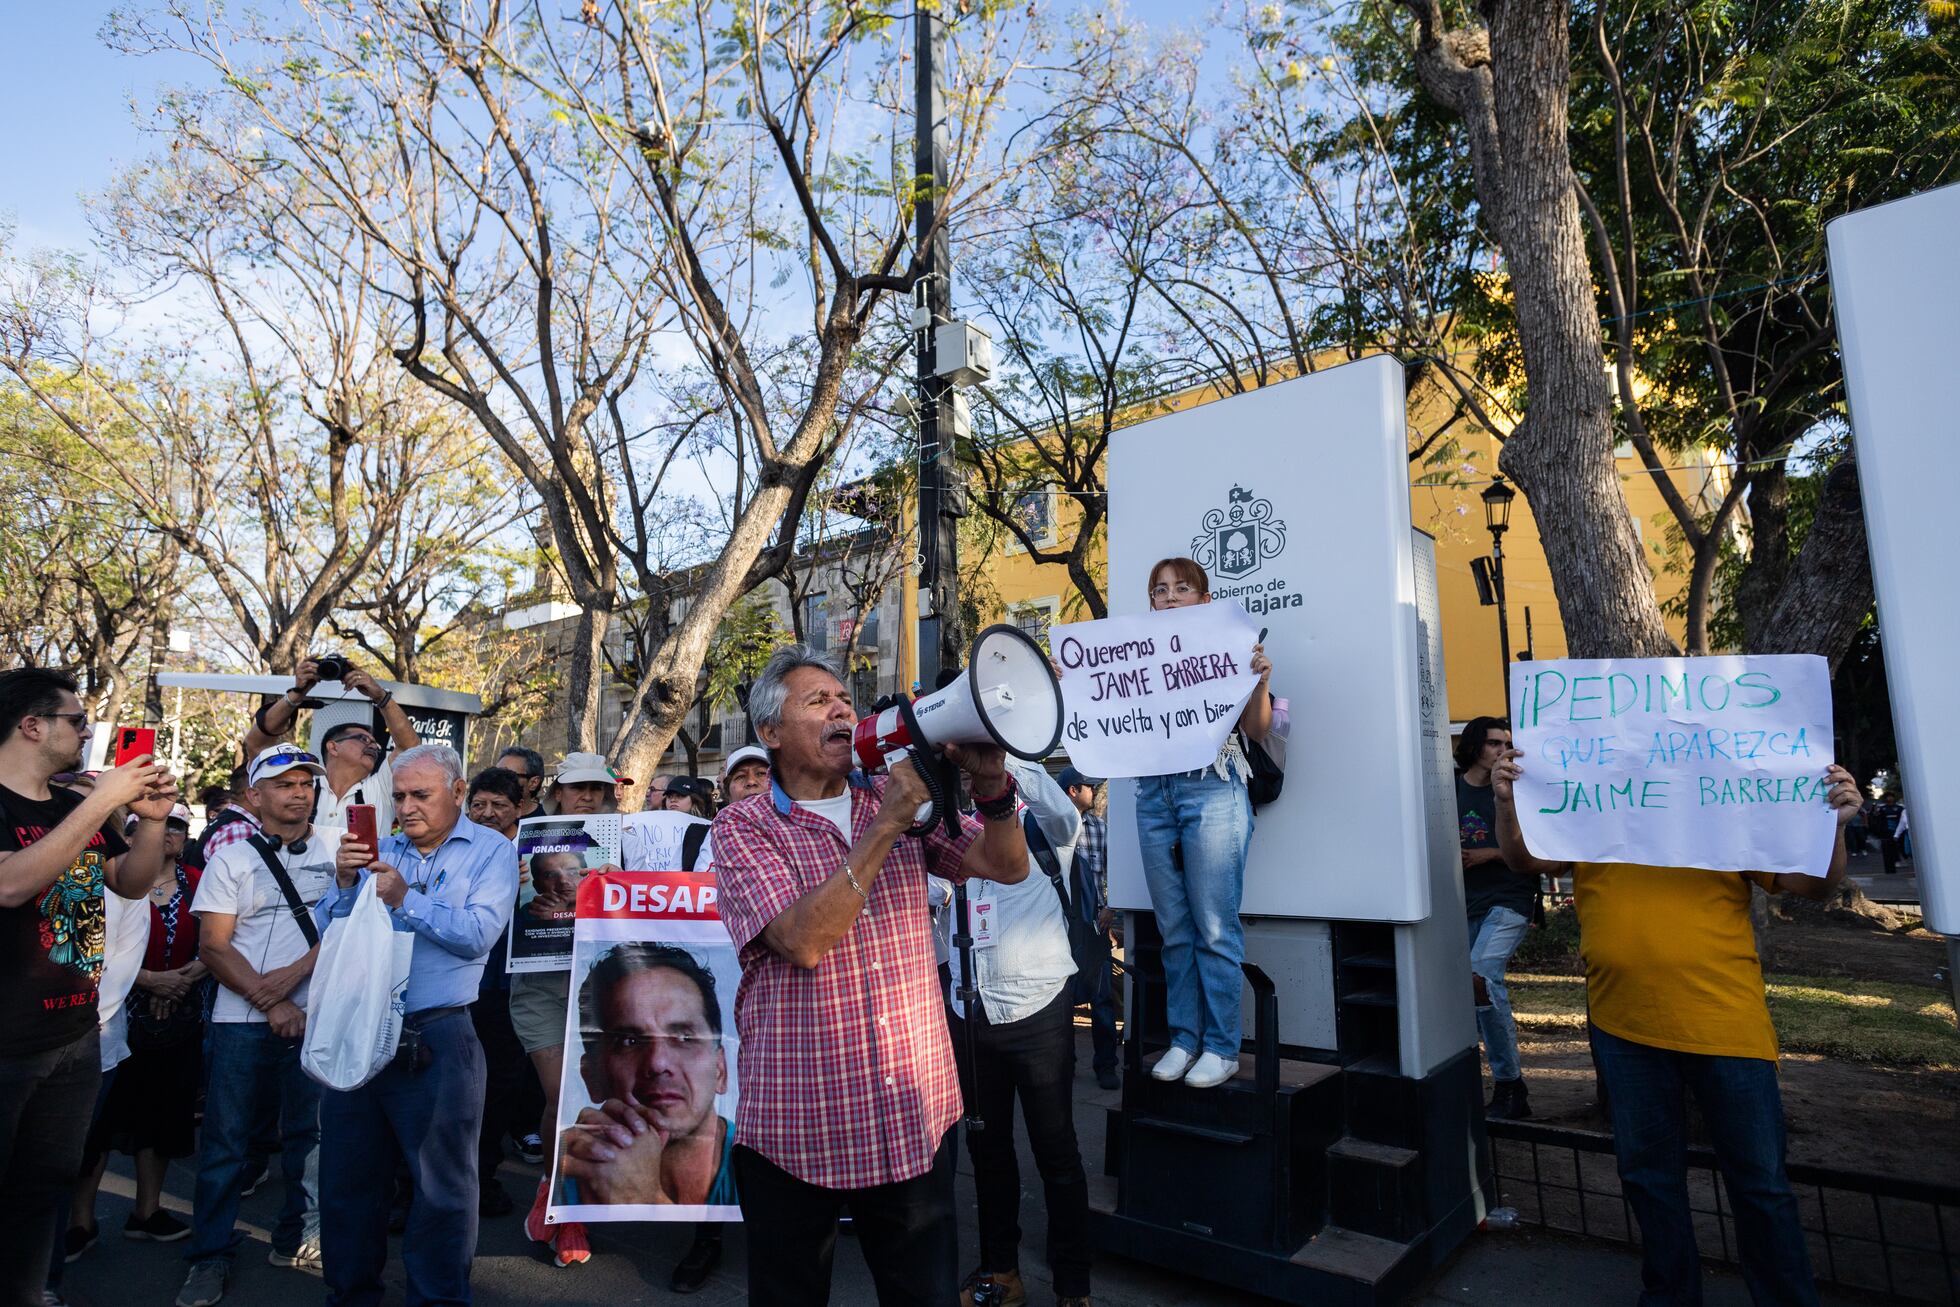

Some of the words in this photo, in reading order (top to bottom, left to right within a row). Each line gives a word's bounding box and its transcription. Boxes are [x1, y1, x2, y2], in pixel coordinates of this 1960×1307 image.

[1211, 583, 1263, 600] obierno
[1267, 578, 1286, 591] de
[1245, 593, 1303, 616] lajara
[1060, 637, 1155, 669] Queremos
[1170, 635, 1182, 653] a
[1090, 668, 1153, 702] JAIME
[1162, 652, 1238, 691] BARRERA
[1519, 670, 1782, 729] ¡PEDIMOS
[436, 719, 453, 737] Jr.
[1067, 712, 1088, 742] de
[1097, 708, 1154, 737] vuelta
[1160, 712, 1171, 739] y
[1175, 708, 1199, 728] con
[1541, 736, 1617, 770] QUE
[1646, 728, 1811, 769] APAREZCA
[1539, 778, 1671, 814] JAIME
[1699, 776, 1830, 807] BARRERA
[532, 844, 571, 854] IGNACIO
